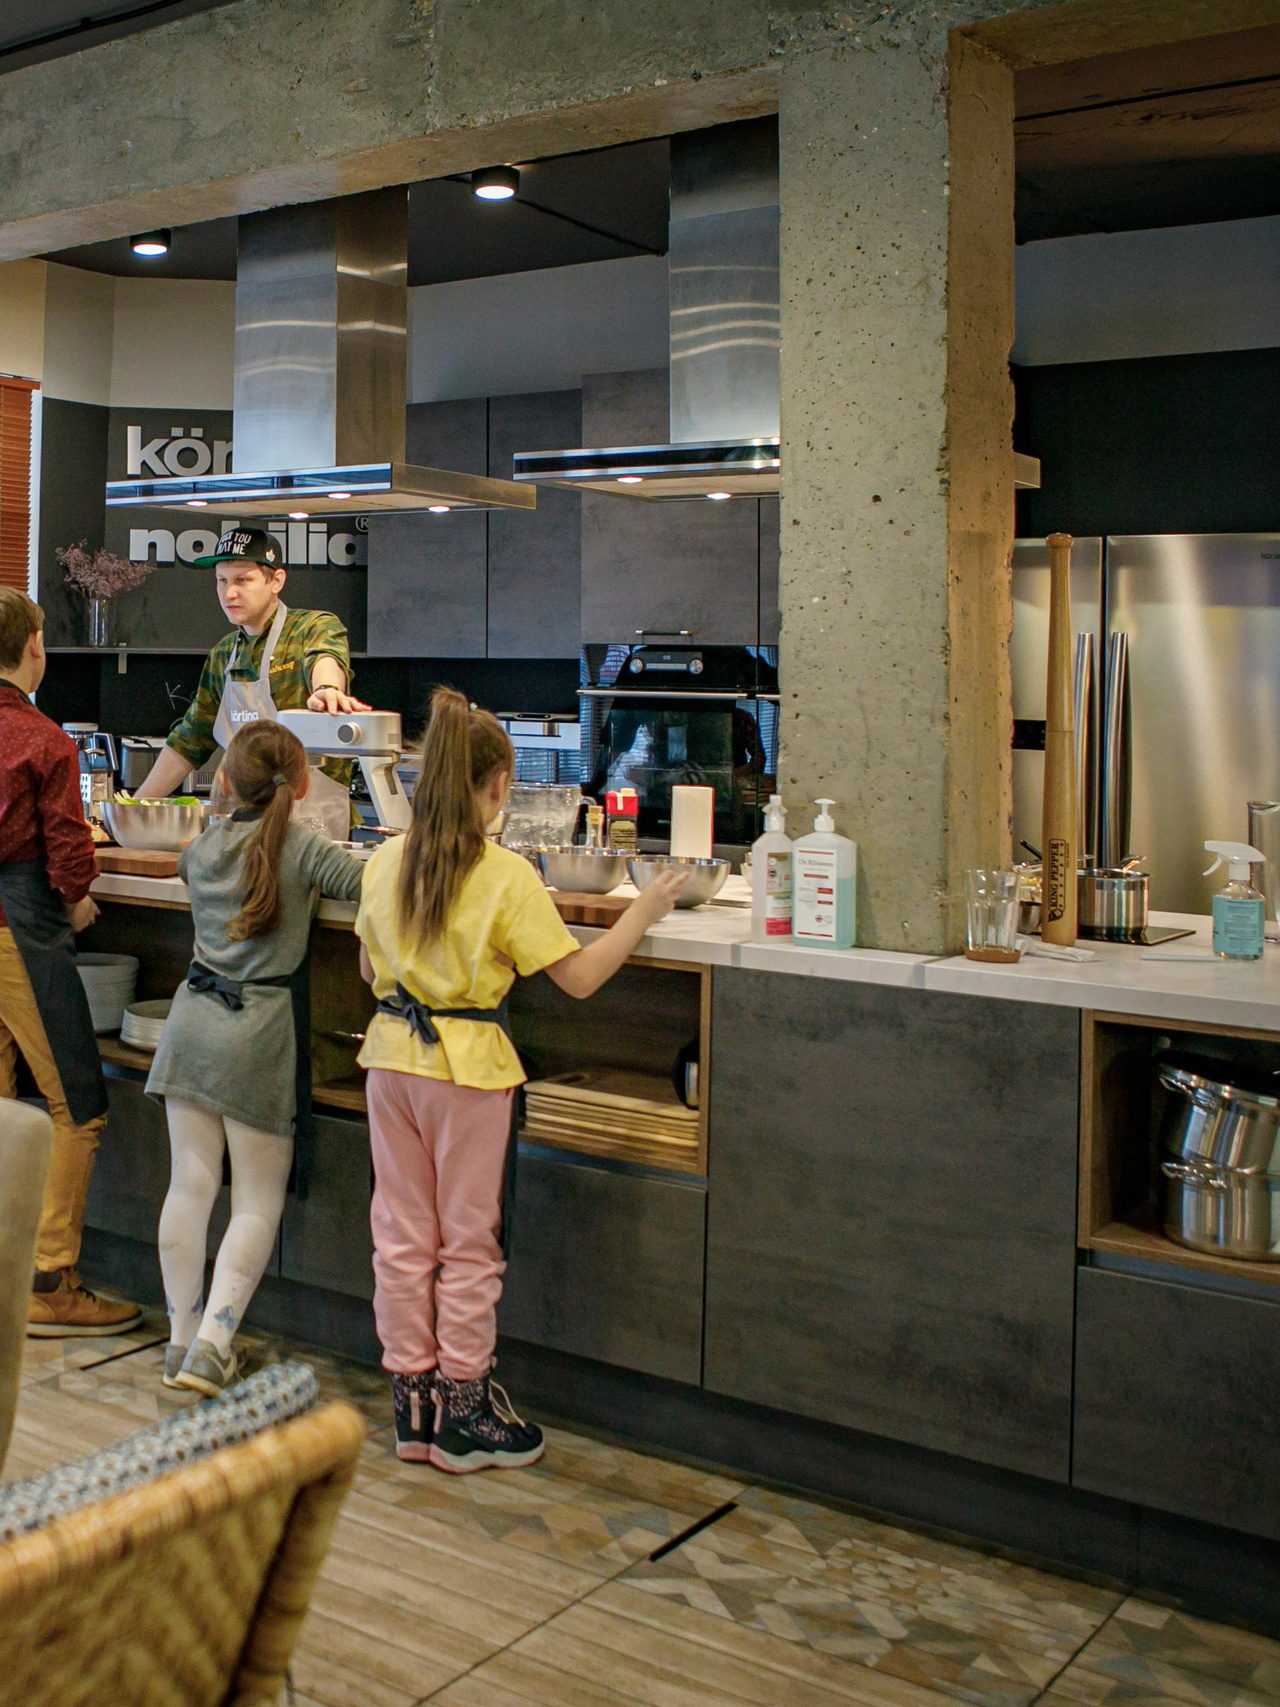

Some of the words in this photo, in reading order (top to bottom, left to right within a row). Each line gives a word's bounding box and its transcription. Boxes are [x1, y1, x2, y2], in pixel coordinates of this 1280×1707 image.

[130, 521, 368, 565] noilia
[232, 543, 246, 555] ME
[234, 532, 252, 544] YOU
[1050, 842, 1059, 881] PEPPER
[1050, 883, 1058, 908] KING
